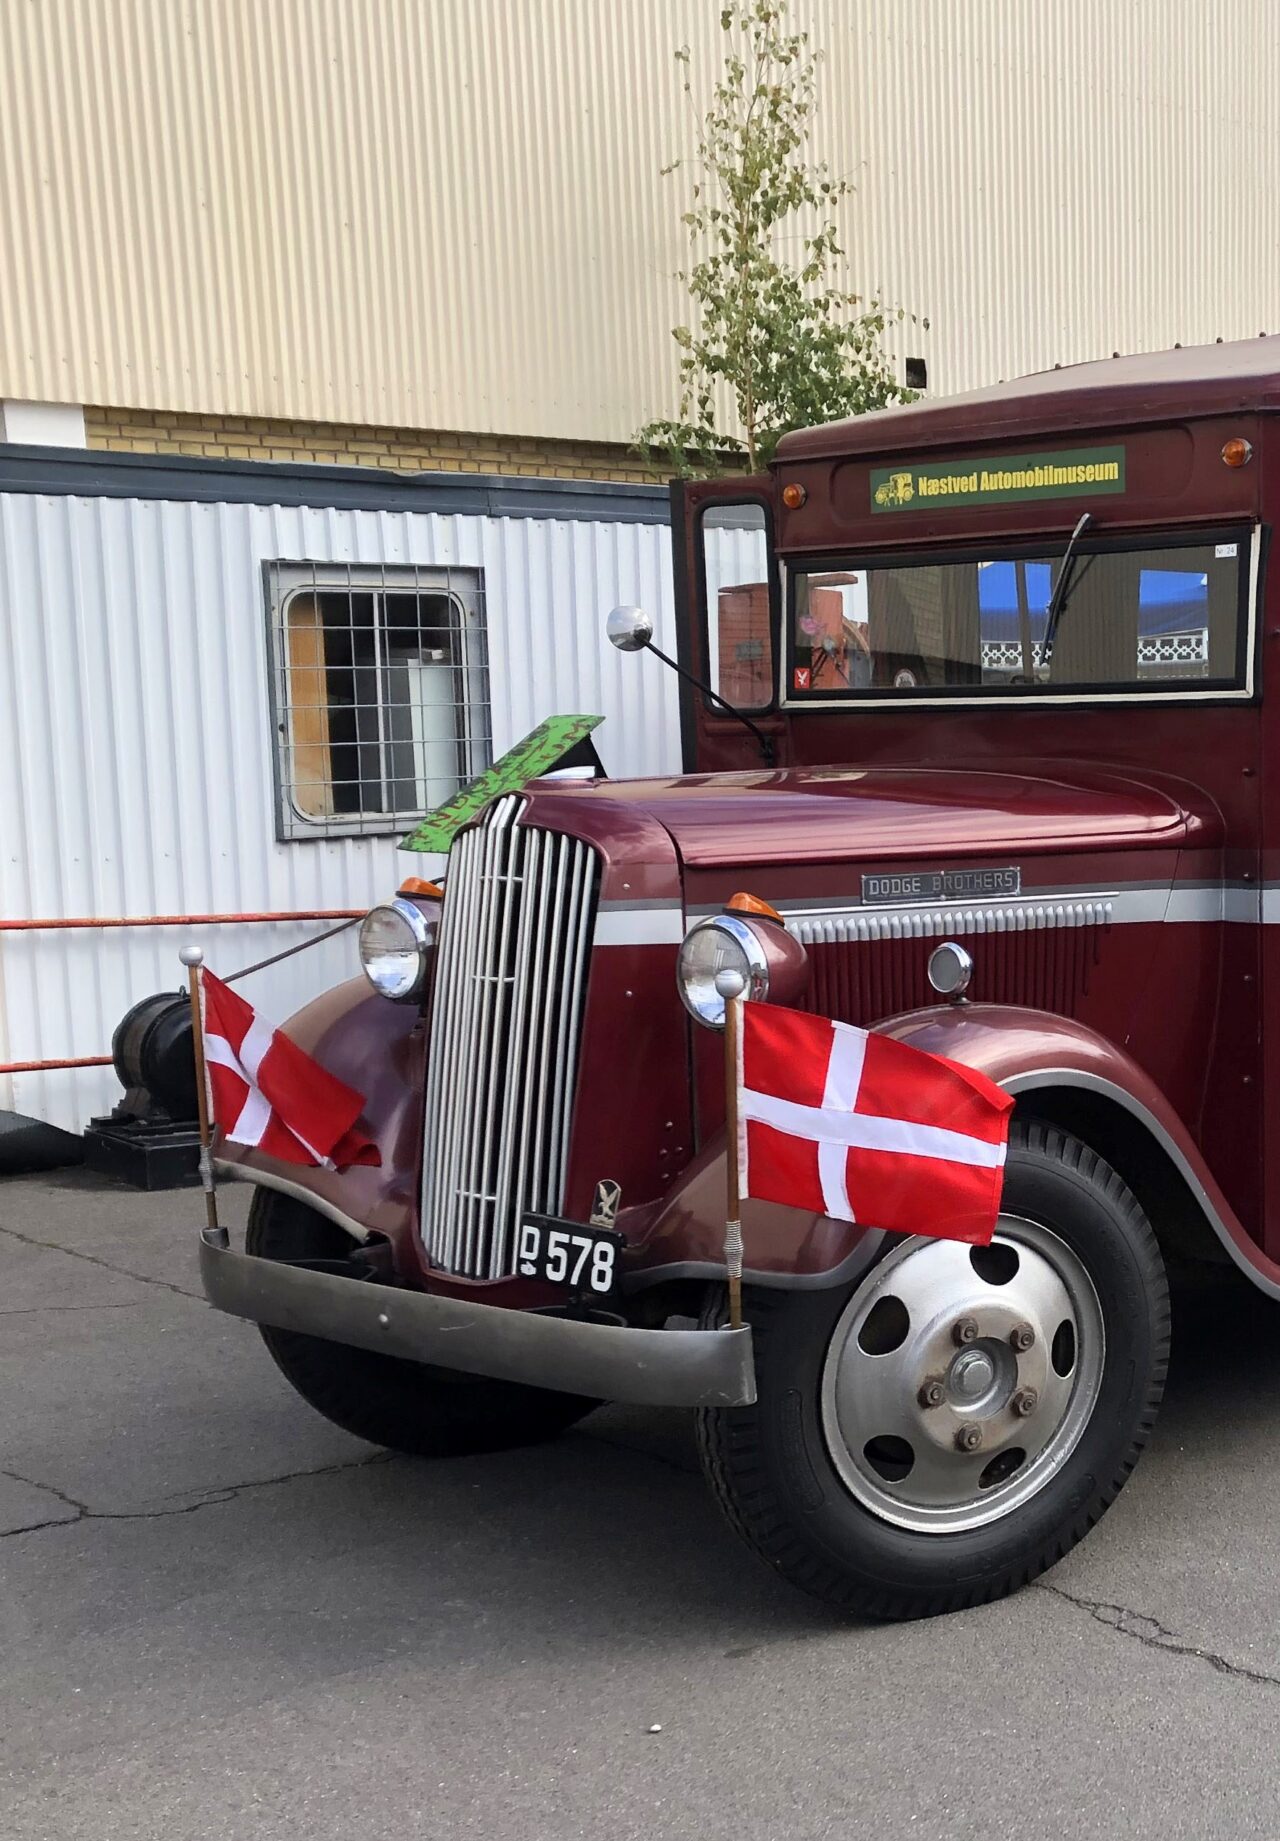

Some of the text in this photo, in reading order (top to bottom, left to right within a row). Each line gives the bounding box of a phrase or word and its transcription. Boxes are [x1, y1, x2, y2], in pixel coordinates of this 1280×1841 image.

[918, 461, 1119, 497] Næstved Automobilmuseum
[869, 872, 1014, 895] DODGE BROTHERS
[520, 1225, 615, 1292] D 578
